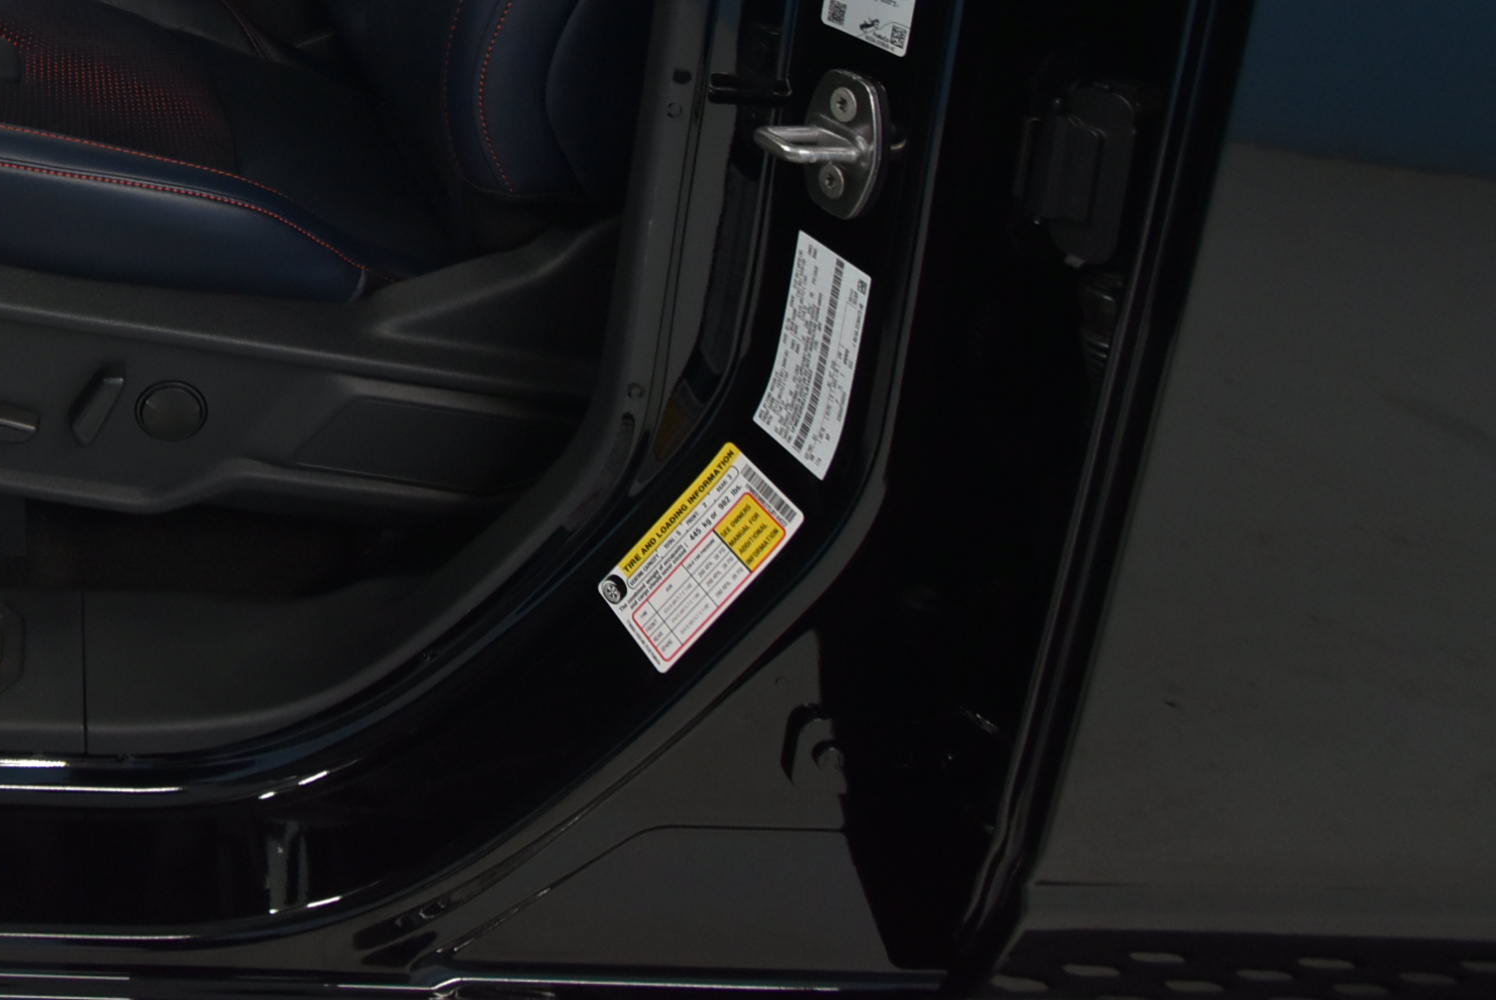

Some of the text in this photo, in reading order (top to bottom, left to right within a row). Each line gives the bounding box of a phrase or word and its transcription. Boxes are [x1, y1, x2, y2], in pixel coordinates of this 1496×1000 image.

[622, 449, 734, 574] TIRE AND LOADING INFORMATION
[687, 525, 702, 541] 445
[700, 516, 713, 530] kg
[709, 510, 718, 520] or
[716, 494, 731, 510] 982
[719, 525, 731, 538] SEE
[728, 503, 752, 528] OWNERS
[727, 522, 749, 547] MANUAL
[747, 511, 760, 525] FOR
[737, 521, 767, 554] ADDITIONAL
[744, 527, 779, 566] INFORMATION
